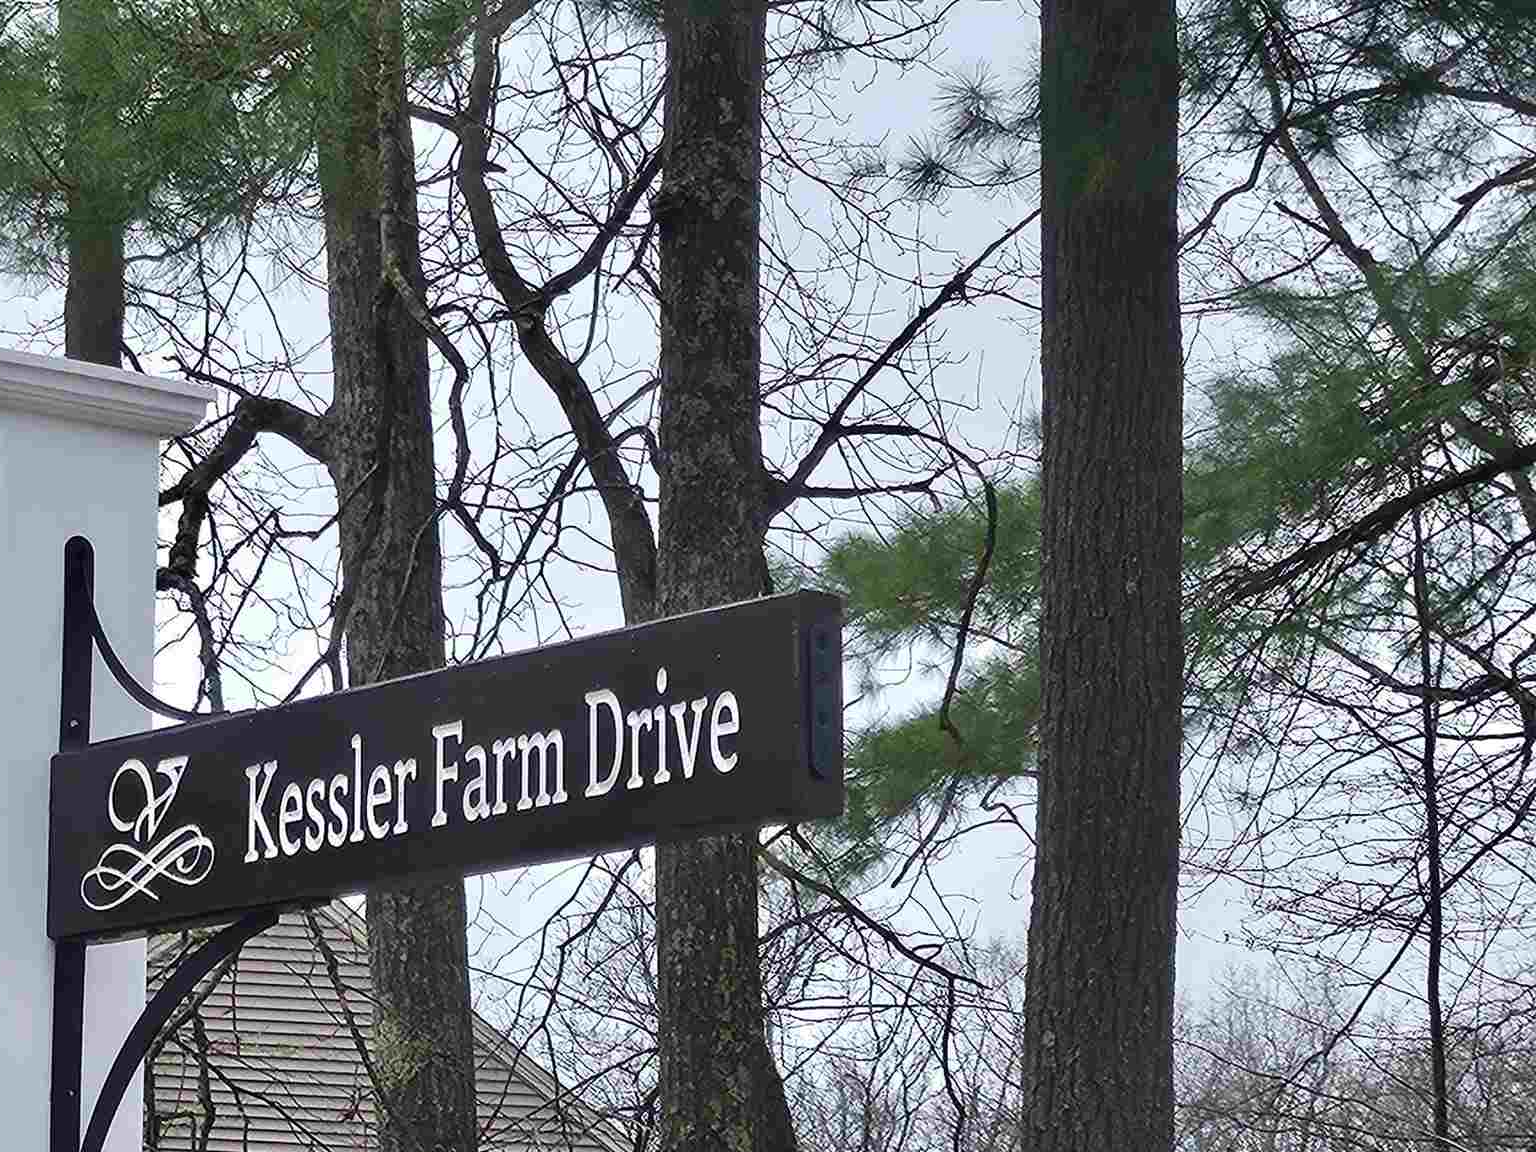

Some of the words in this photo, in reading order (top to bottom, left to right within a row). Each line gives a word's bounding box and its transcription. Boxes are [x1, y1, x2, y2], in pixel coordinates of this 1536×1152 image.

[244, 733, 417, 864] Kessler
[431, 719, 569, 828] Farm
[584, 666, 740, 798] Drive
